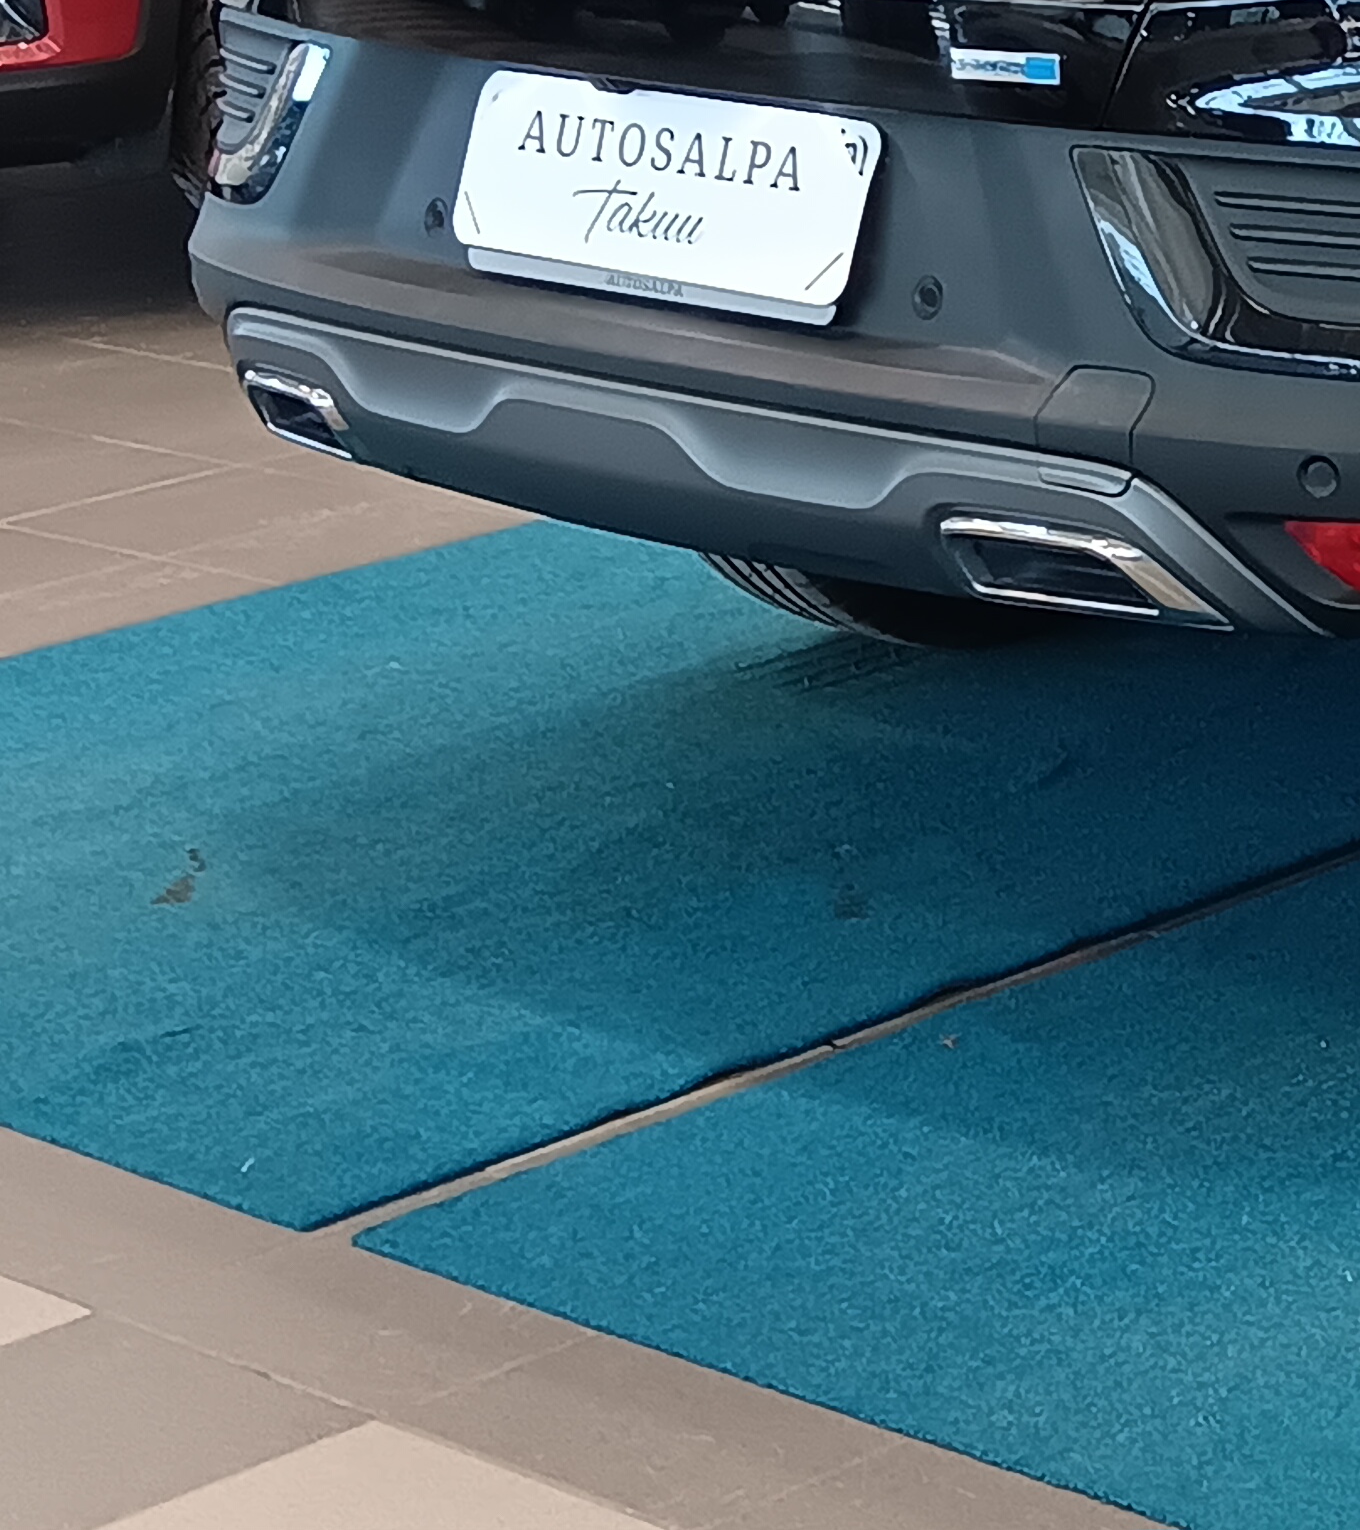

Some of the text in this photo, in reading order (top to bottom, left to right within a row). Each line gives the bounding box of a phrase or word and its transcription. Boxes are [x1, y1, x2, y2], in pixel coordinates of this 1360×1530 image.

[518, 109, 803, 192] AUTOSALPA
[572, 177, 705, 246] Takuu
[603, 273, 684, 299] AUTOSALPA
